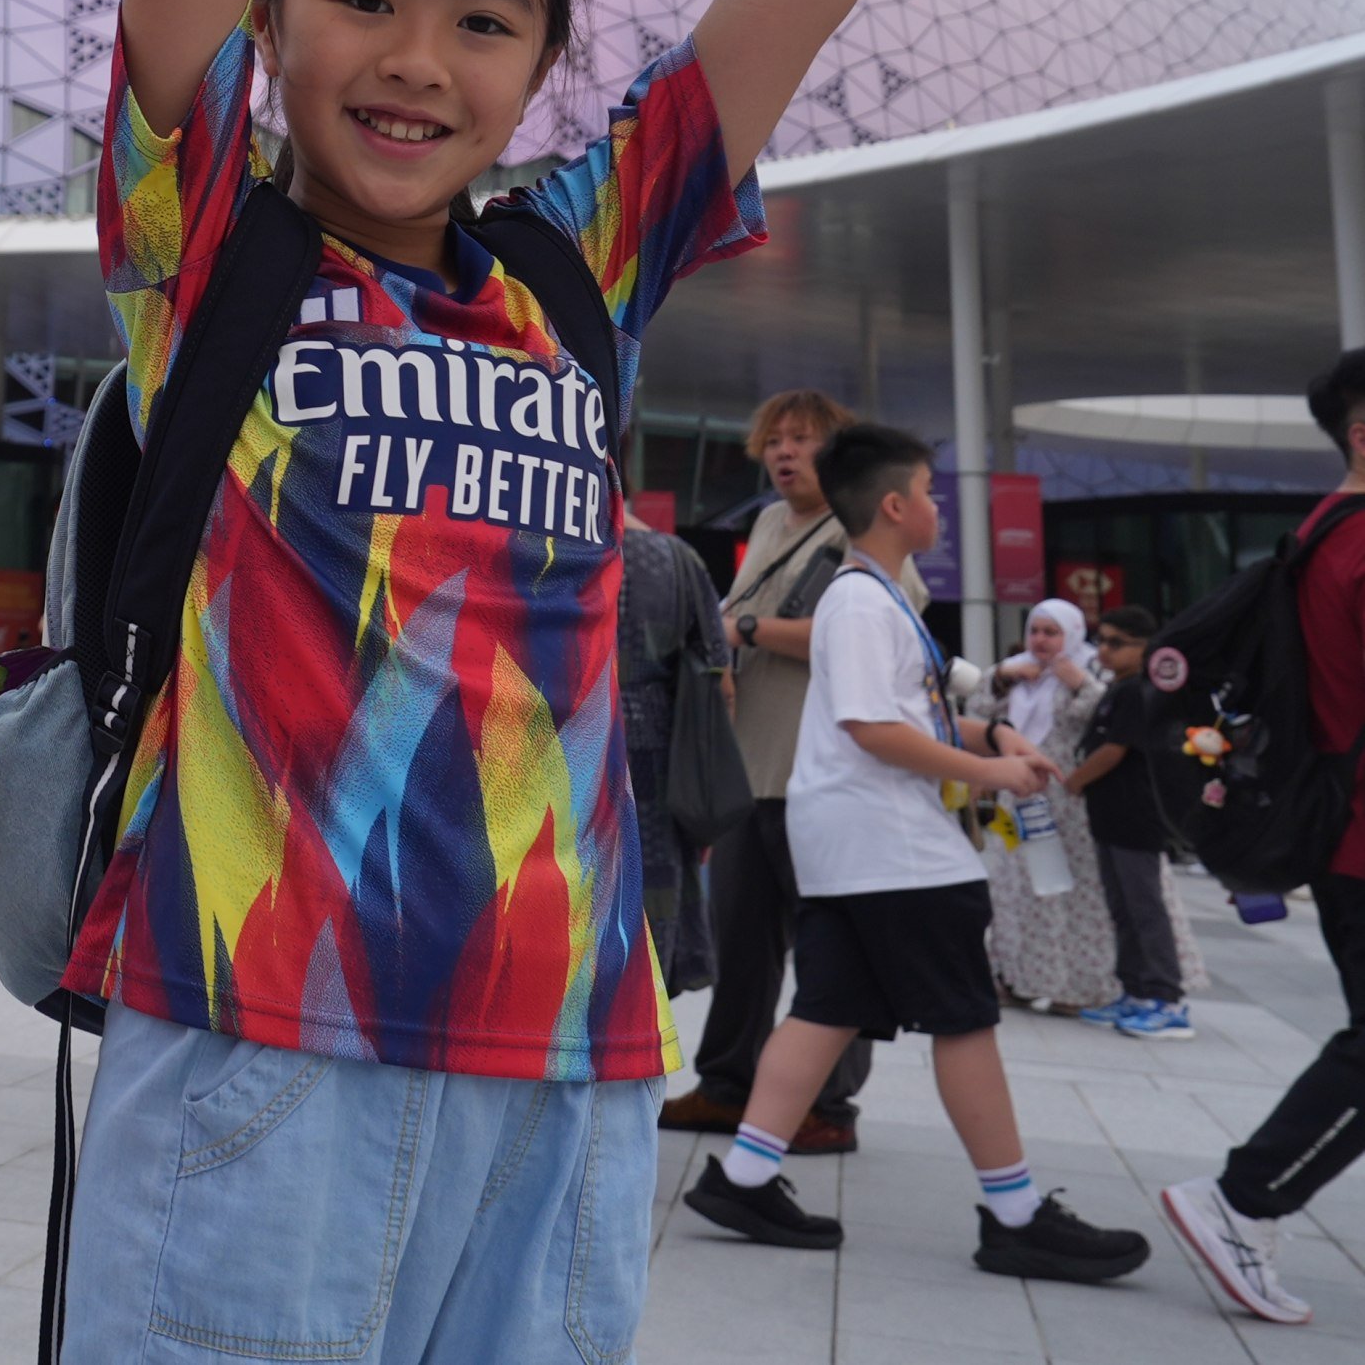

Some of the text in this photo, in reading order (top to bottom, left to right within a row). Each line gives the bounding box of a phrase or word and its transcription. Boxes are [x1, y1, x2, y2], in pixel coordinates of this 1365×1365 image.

[274, 338, 607, 460] Emirate
[337, 435, 603, 545] FLY BETTER
